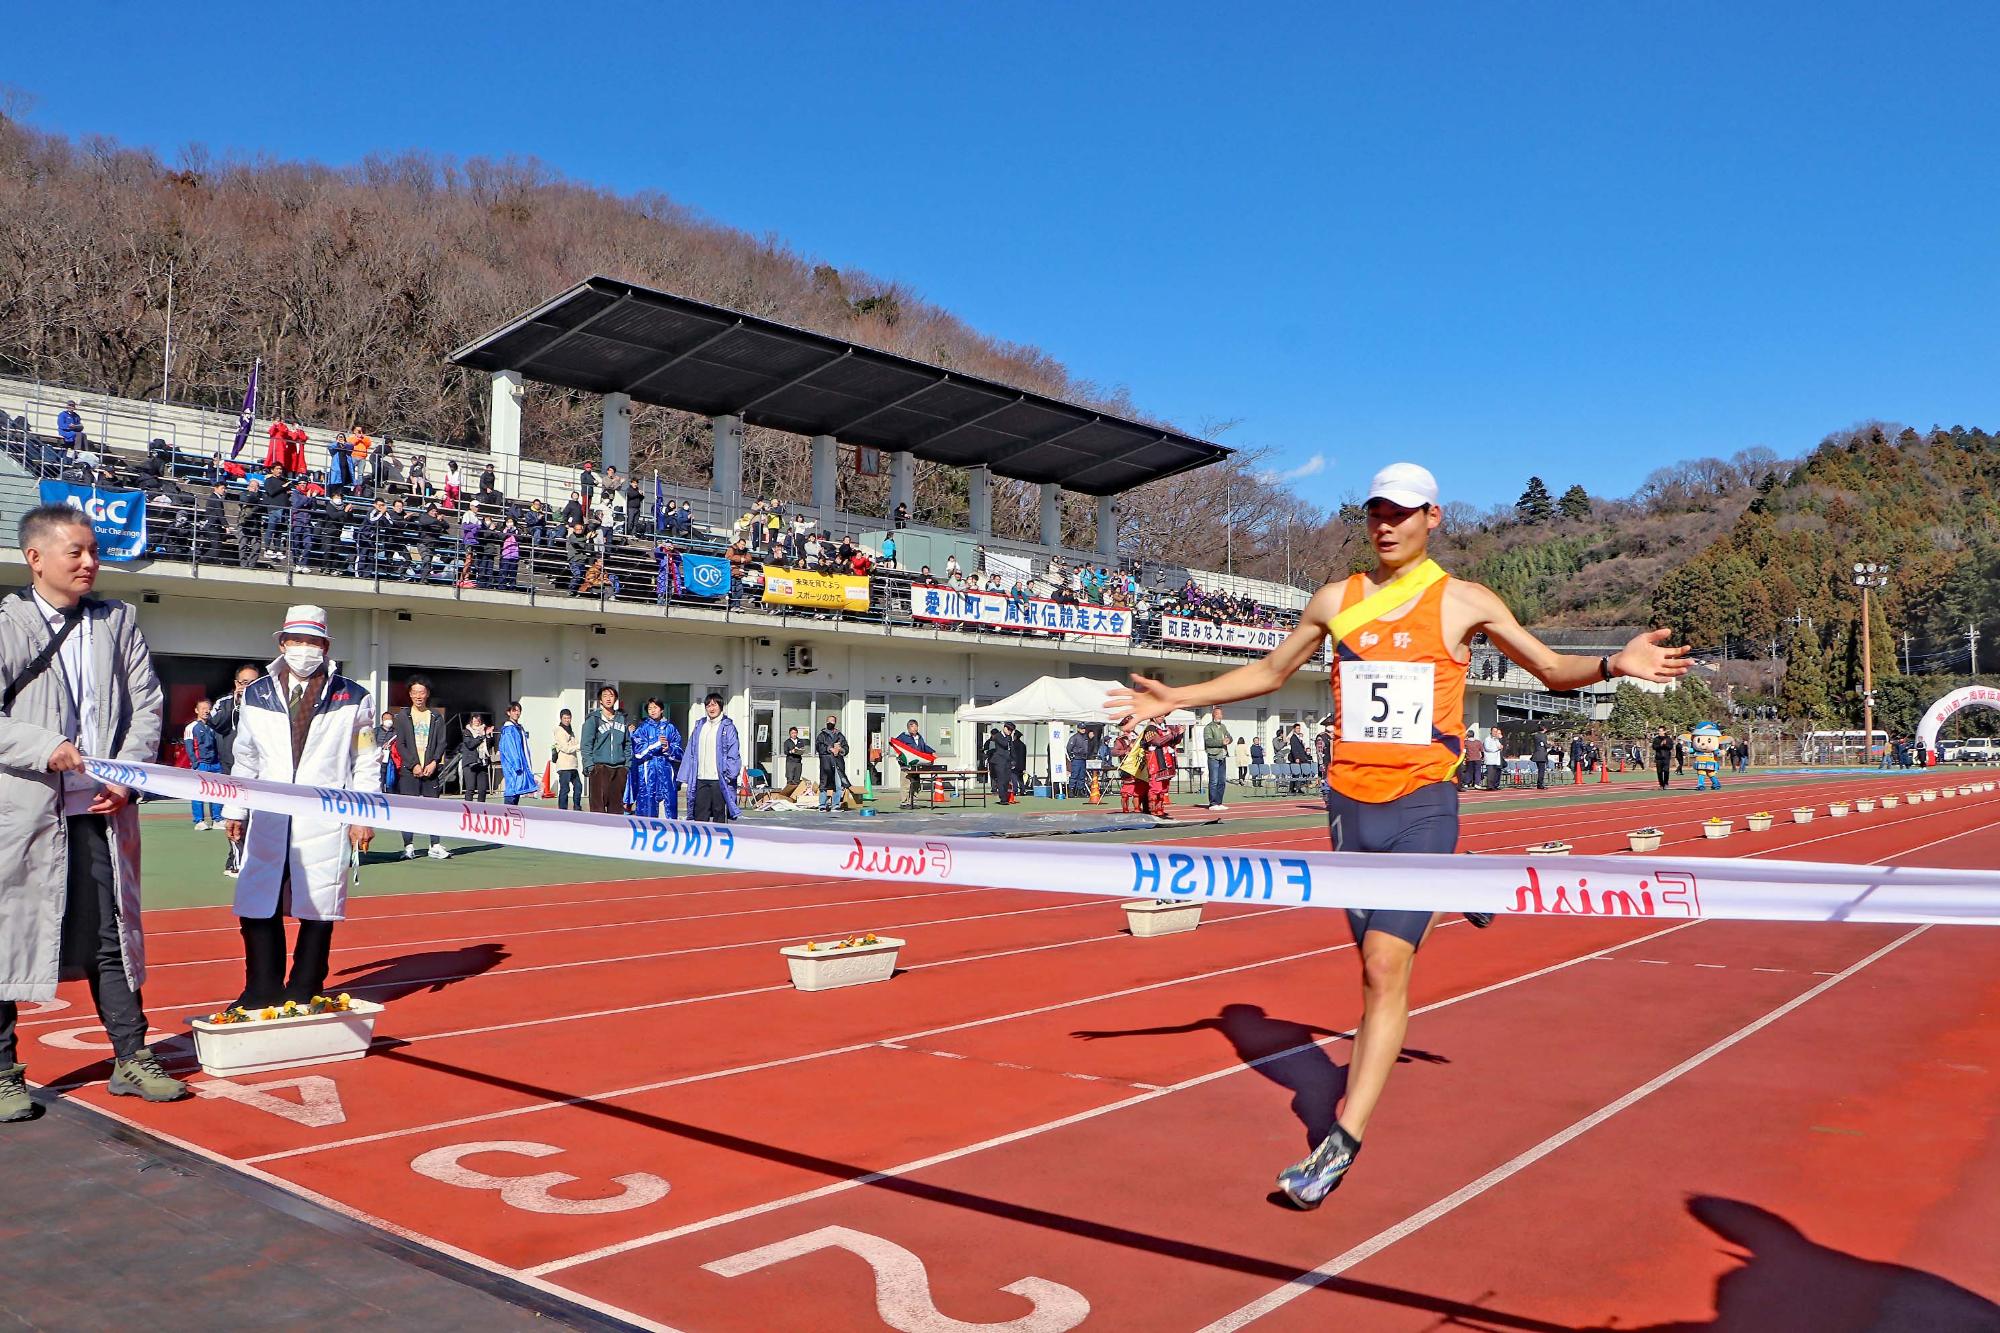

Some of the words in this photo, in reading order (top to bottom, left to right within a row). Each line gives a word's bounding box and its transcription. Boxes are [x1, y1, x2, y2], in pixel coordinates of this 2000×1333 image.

[924, 590, 1125, 633] 愛川町一周駅伝競走大会
[189, 1075, 347, 1127] 4
[410, 1140, 671, 1215] 3
[699, 1224, 1091, 1333] 2
